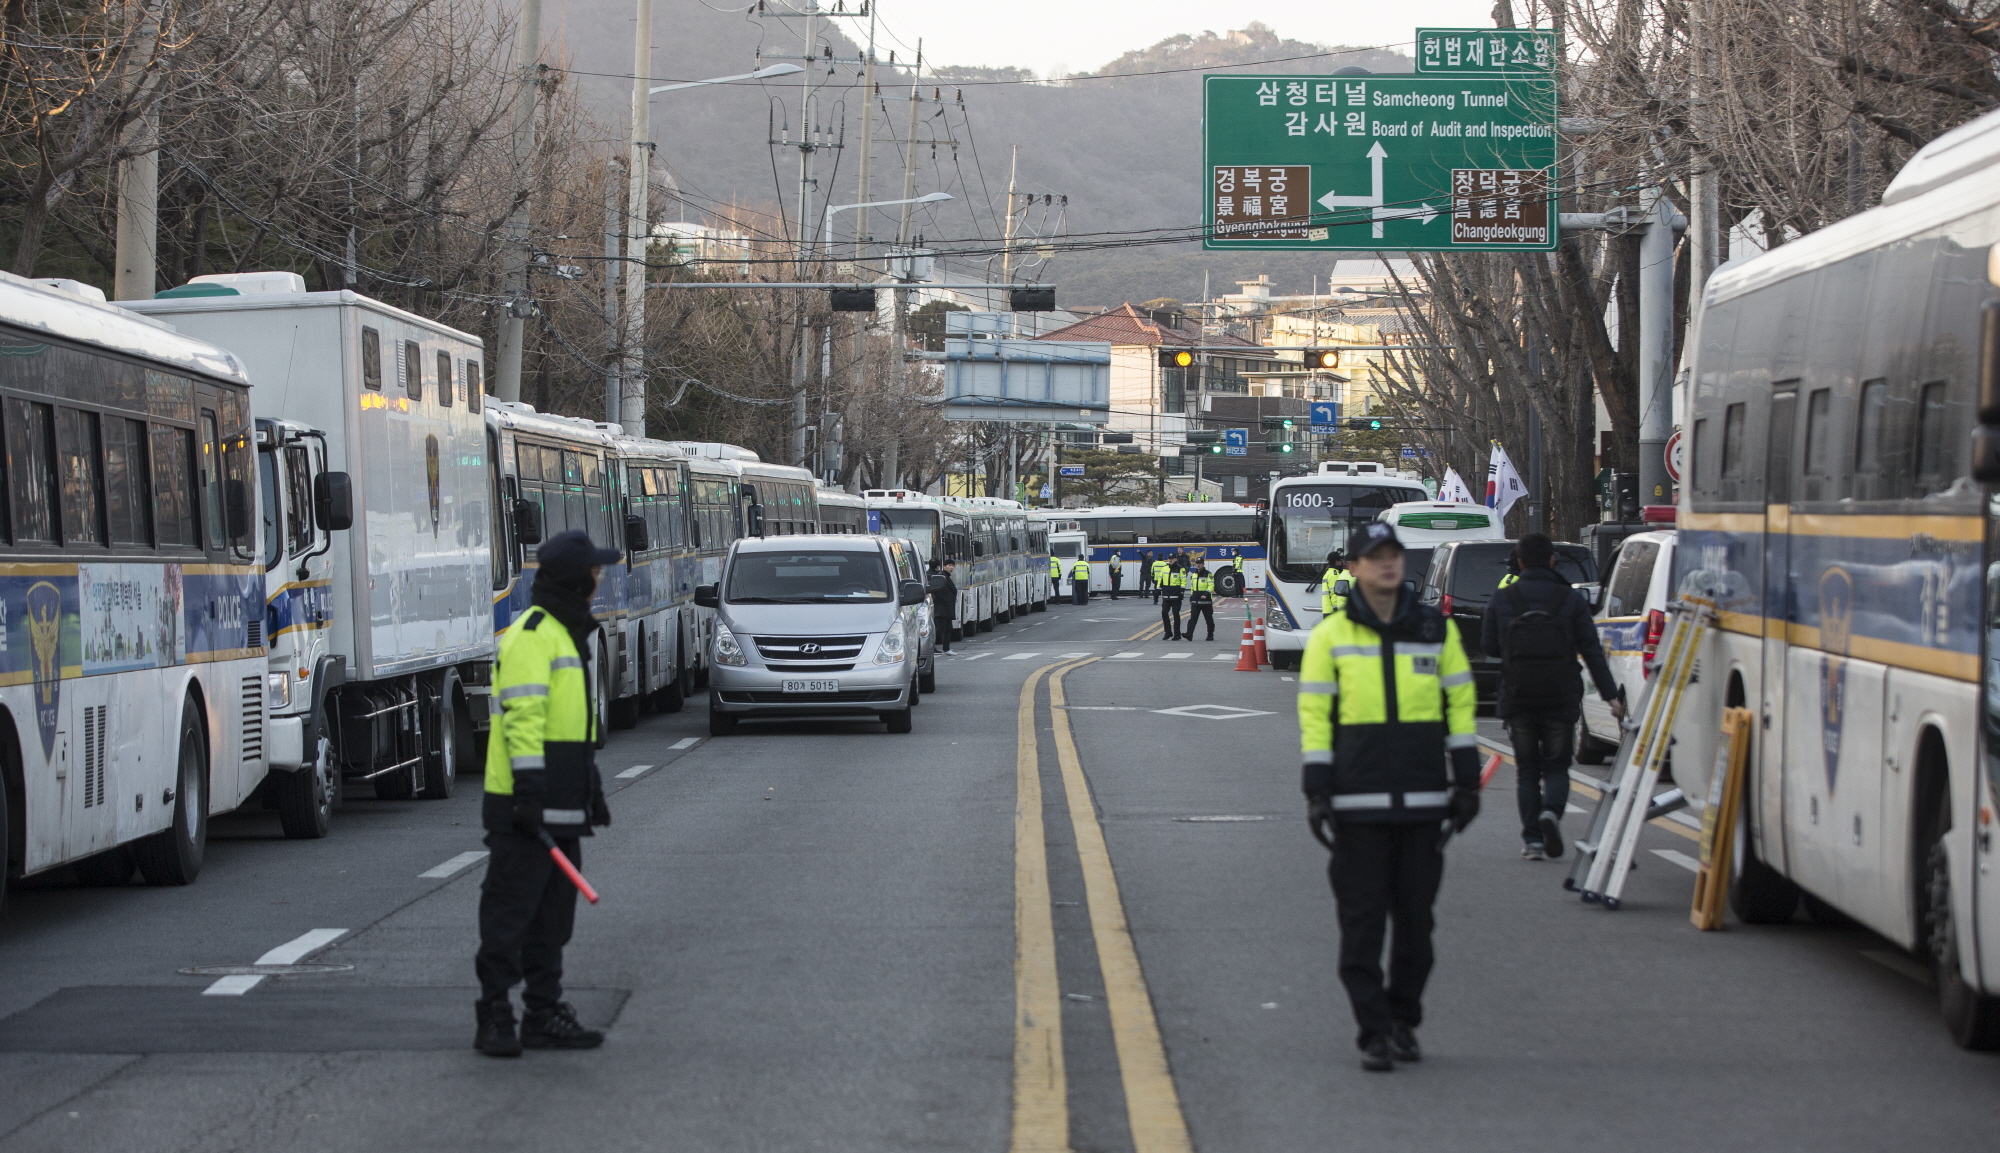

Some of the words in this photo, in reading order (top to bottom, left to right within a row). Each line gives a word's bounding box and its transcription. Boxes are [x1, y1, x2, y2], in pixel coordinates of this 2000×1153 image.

[1423, 37, 1549, 67] 헌법재판소앞
[1256, 81, 1366, 106] 삼청터널
[1372, 90, 1455, 110] Samcheong
[1461, 90, 1508, 107] Tunnel
[1285, 111, 1366, 136] 감사원
[1372, 120, 1407, 137] Board
[1411, 121, 1424, 137] of
[1430, 121, 1462, 137] Audit
[1465, 121, 1487, 137] and
[1491, 121, 1551, 141] Inspection
[1216, 168, 1288, 193] 경복궁
[1455, 170, 1521, 196] 창덕궁
[1216, 195, 1288, 216] 景福宮
[1454, 222, 1546, 242] Changdeokgung
[1226, 447, 1247, 455] 비보호
[1285, 493, 1335, 508] 1600-3
[218, 595, 241, 630] POLICE
[810, 681, 834, 691] 5015
